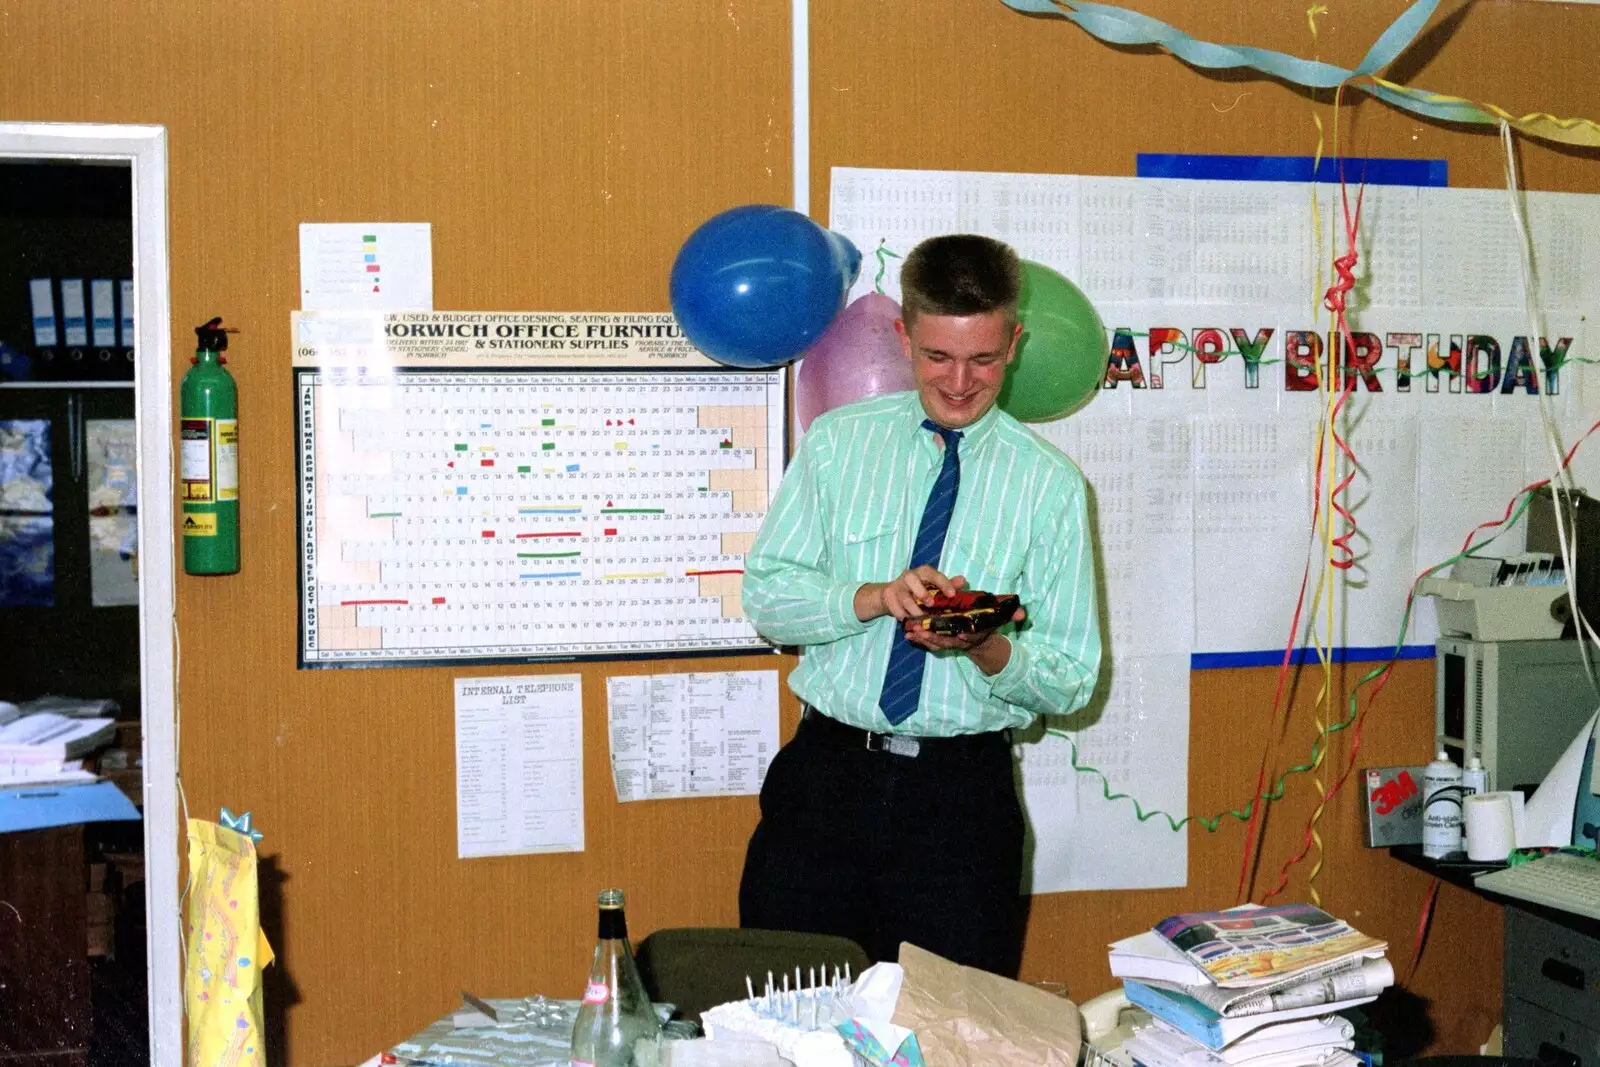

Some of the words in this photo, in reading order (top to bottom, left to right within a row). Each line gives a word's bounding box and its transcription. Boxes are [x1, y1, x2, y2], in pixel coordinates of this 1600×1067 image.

[522, 315, 567, 324] DESKING,
[496, 325, 579, 338] OFFICE
[587, 325, 686, 338] FURNITU
[475, 340, 485, 348] &
[489, 340, 566, 349] STATIONERY
[570, 340, 628, 349] SUPPLIES
[1100, 328, 1274, 389] APPY
[1284, 330, 1574, 395] BIRTHDAY
[462, 685, 512, 696] INTERNAL
[517, 683, 573, 694] TELEPHONE
[502, 695, 526, 705] LIST
[1370, 771, 1419, 816] 3M
